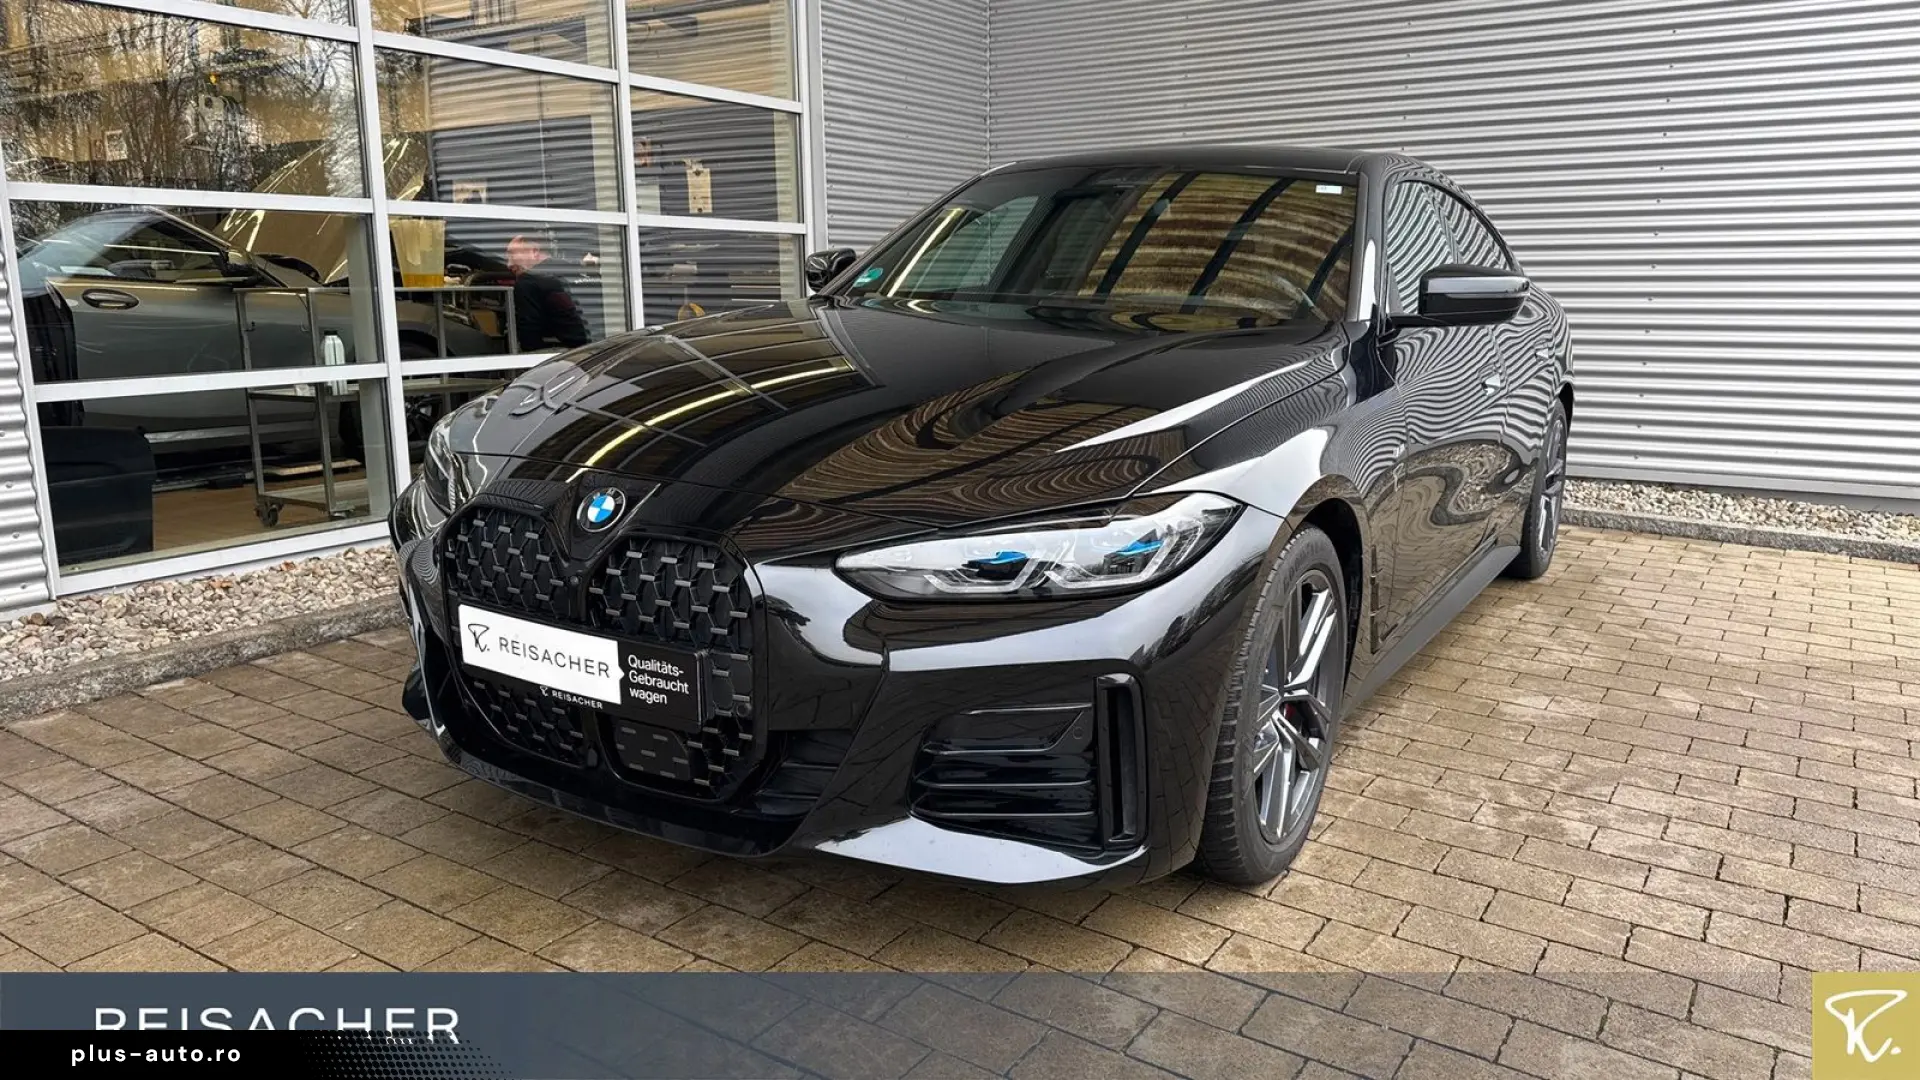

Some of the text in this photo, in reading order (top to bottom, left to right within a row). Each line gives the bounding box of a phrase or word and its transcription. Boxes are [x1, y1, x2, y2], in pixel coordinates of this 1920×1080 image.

[498, 636, 611, 679] REISACHER
[628, 654, 684, 677] Qualitäts-
[628, 670, 689, 695] Gebraucht
[551, 689, 603, 710] REISACHER
[629, 687, 668, 705] wagen
